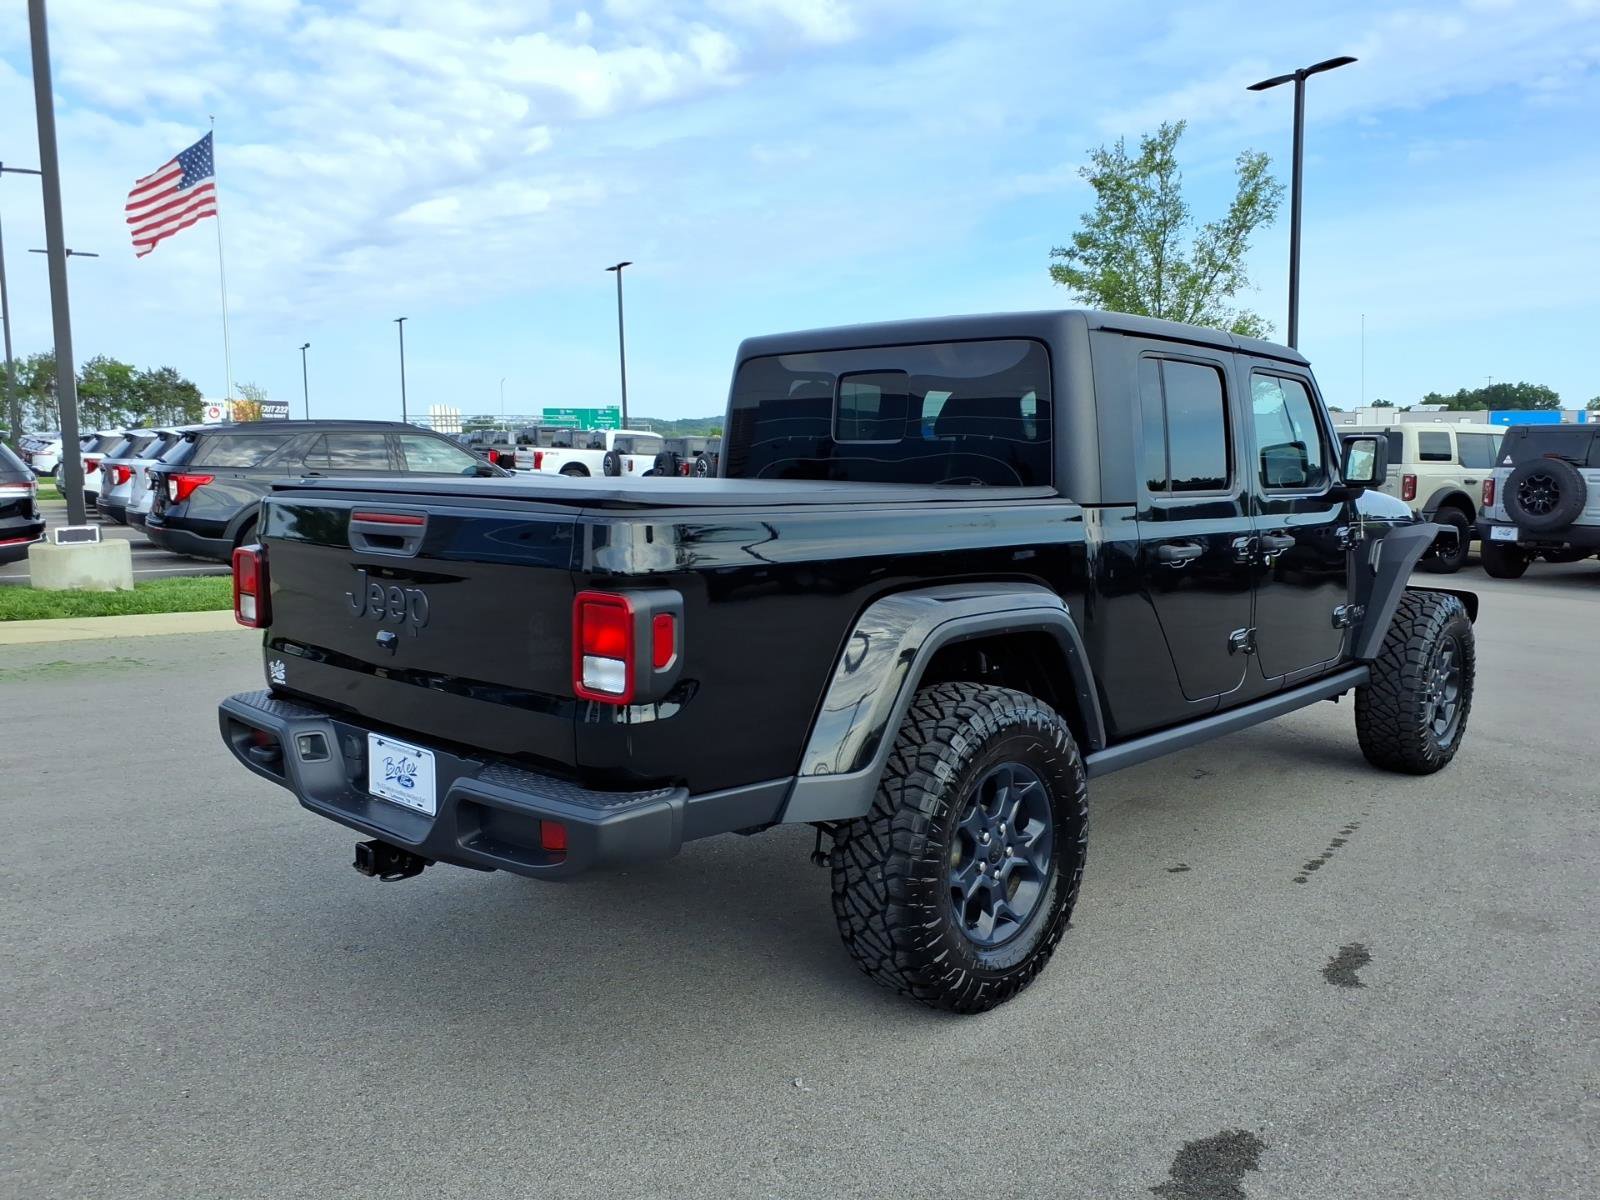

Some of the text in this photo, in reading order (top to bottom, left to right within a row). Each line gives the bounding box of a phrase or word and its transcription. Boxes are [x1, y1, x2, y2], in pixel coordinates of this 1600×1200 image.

[275, 405, 289, 413] 232
[345, 568, 430, 638] Jeep
[383, 756, 418, 777] Bates
